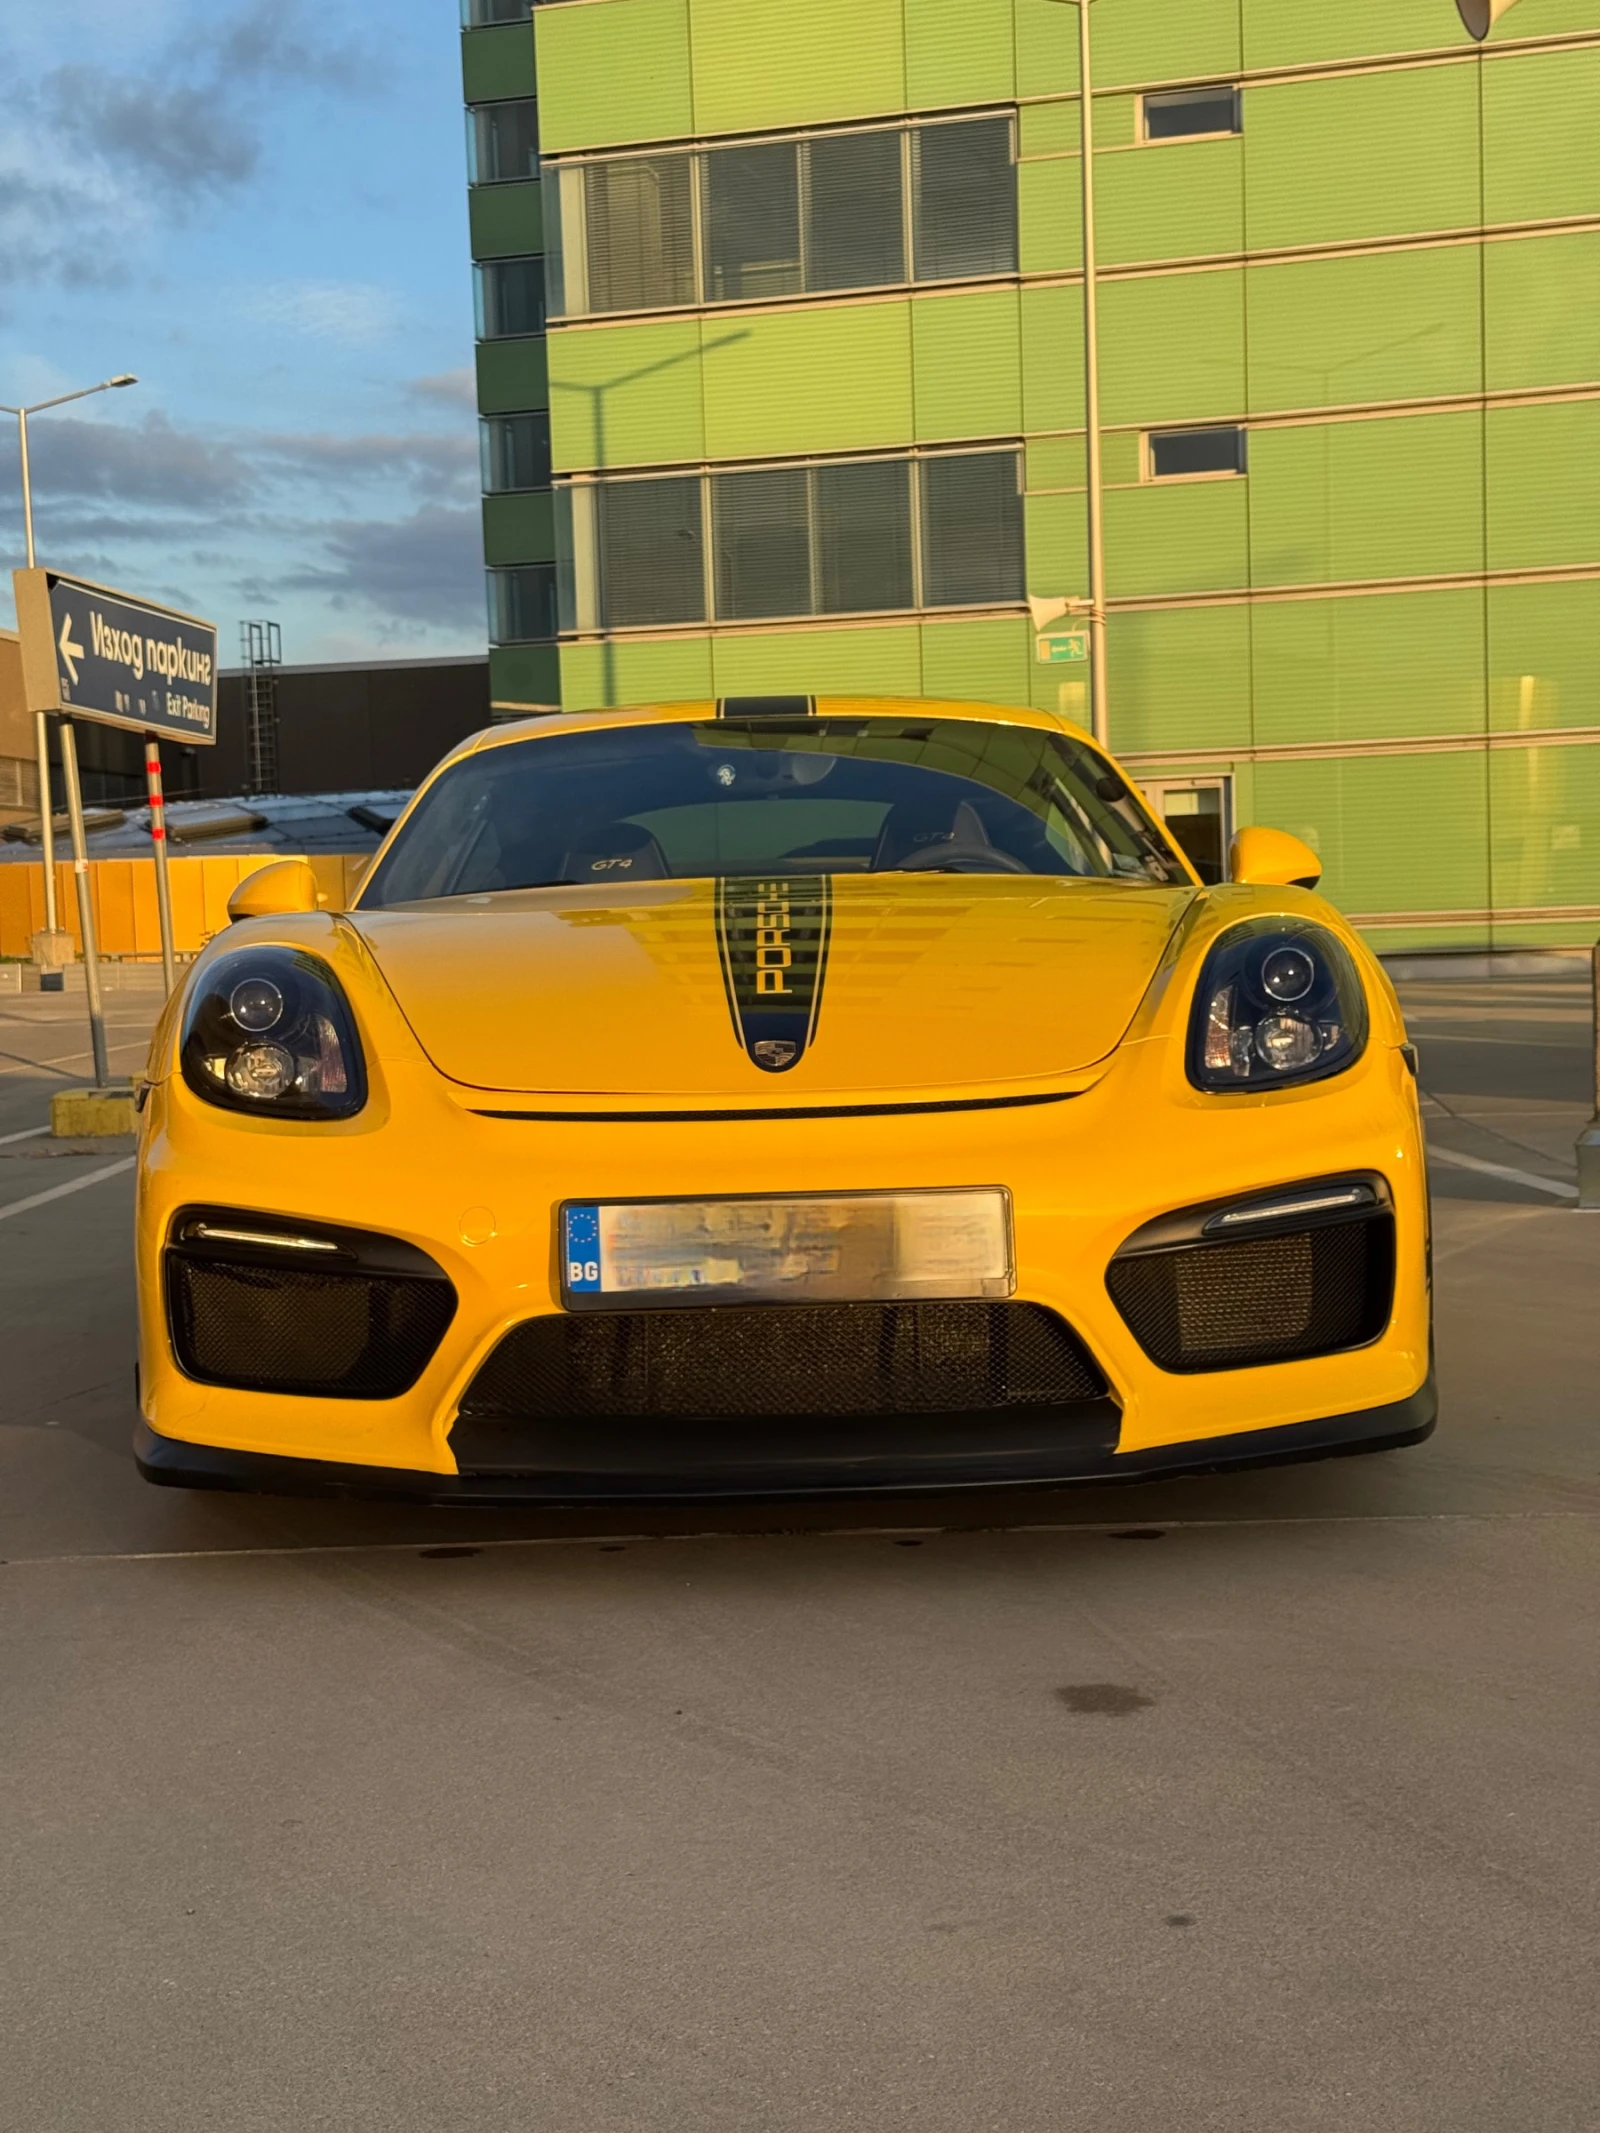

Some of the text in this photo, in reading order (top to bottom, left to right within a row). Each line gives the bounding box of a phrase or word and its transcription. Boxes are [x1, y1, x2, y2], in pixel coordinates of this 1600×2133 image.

[89, 611, 212, 685] Изход паркинг
[166, 691, 210, 729] Exit Parking
[591, 858, 633, 870] GT4
[757, 883, 793, 994] PORSCHE
[569, 1260, 598, 1281] BG
